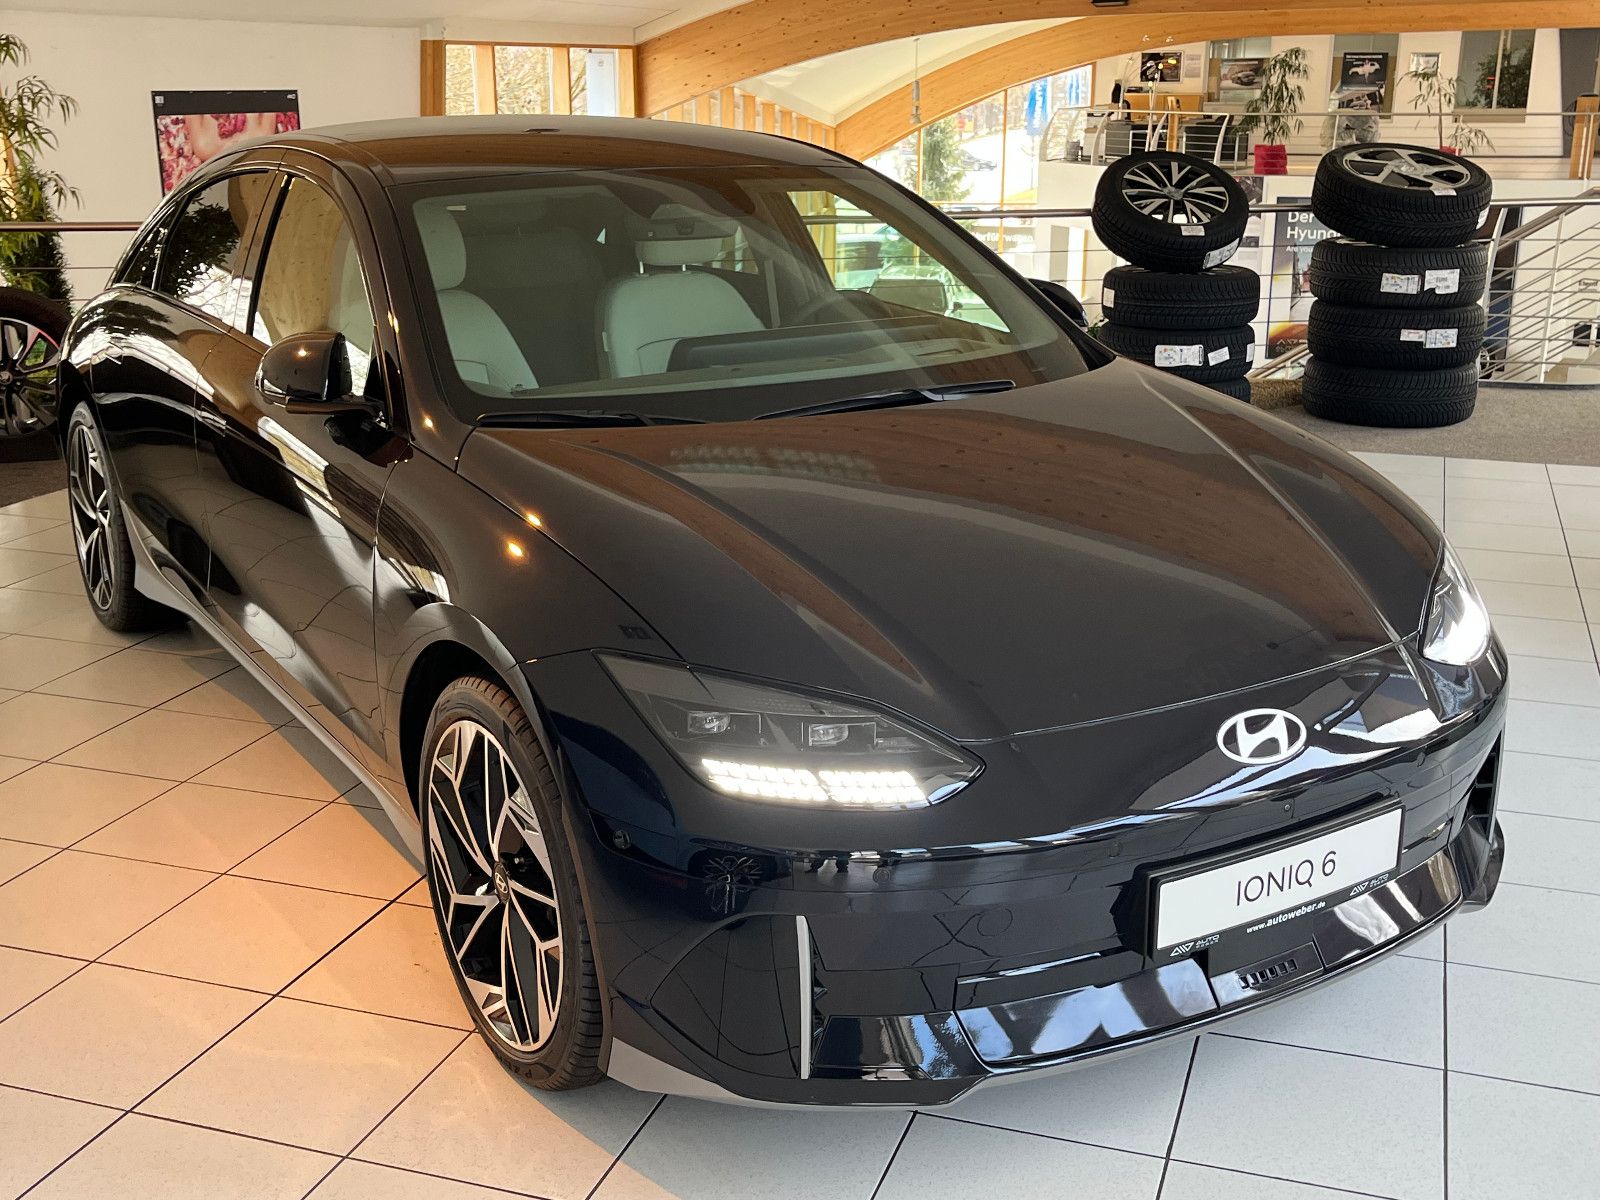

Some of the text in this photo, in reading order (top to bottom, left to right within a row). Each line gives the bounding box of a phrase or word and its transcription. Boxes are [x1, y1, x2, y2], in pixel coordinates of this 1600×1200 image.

[1288, 211, 1314, 223] Der
[1236, 850, 1337, 906] IONIQ 6
[1246, 901, 1326, 933] www.autoweber.de
[1195, 934, 1220, 946] AUTO
